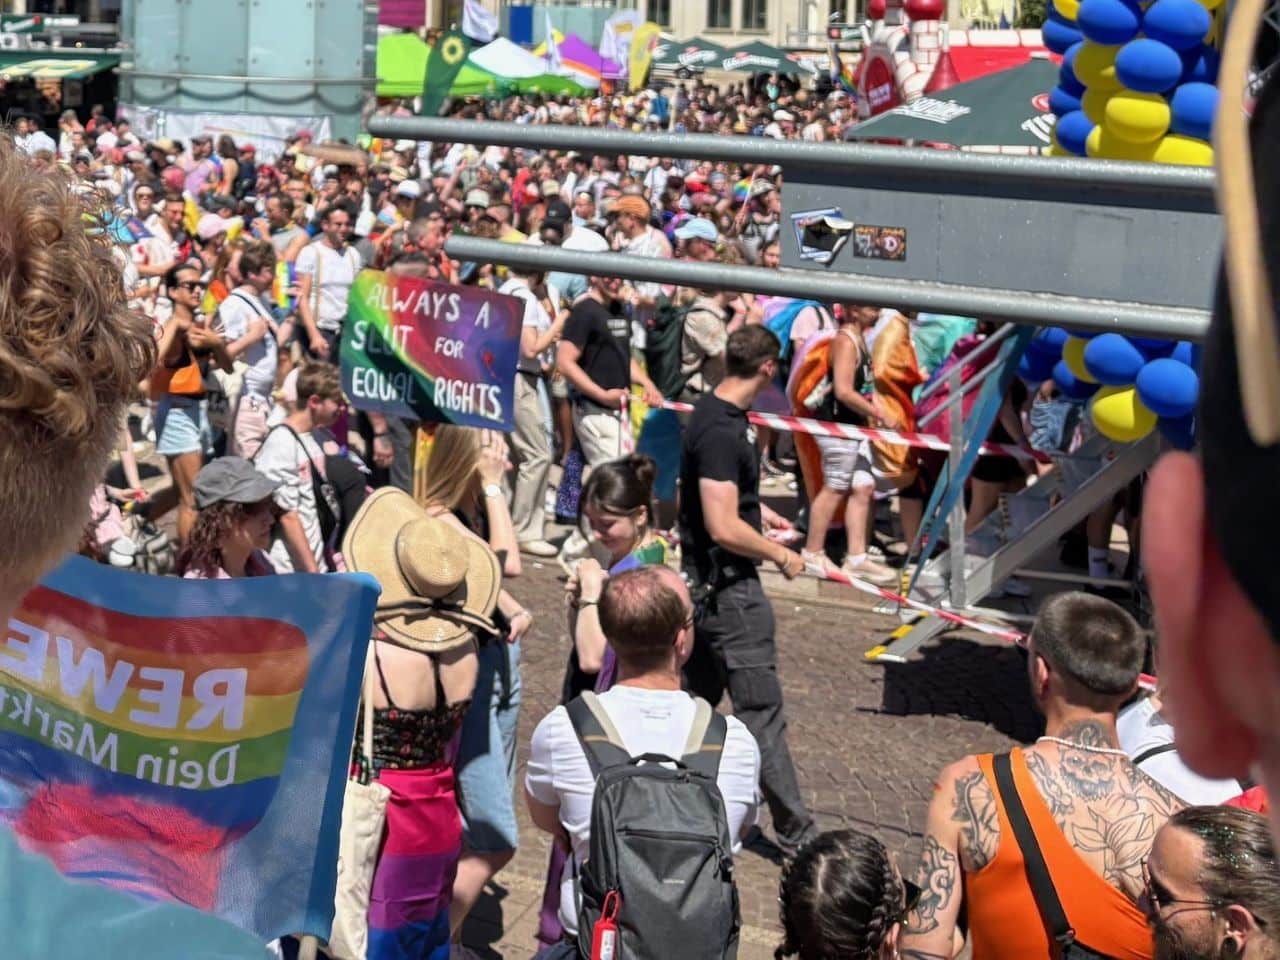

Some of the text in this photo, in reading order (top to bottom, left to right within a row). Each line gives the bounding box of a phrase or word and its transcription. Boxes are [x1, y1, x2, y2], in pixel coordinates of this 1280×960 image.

[367, 283, 491, 329] ALWAYS A
[351, 320, 465, 359] SLUT FOR
[351, 367, 503, 420] EQUAL RIGHTS
